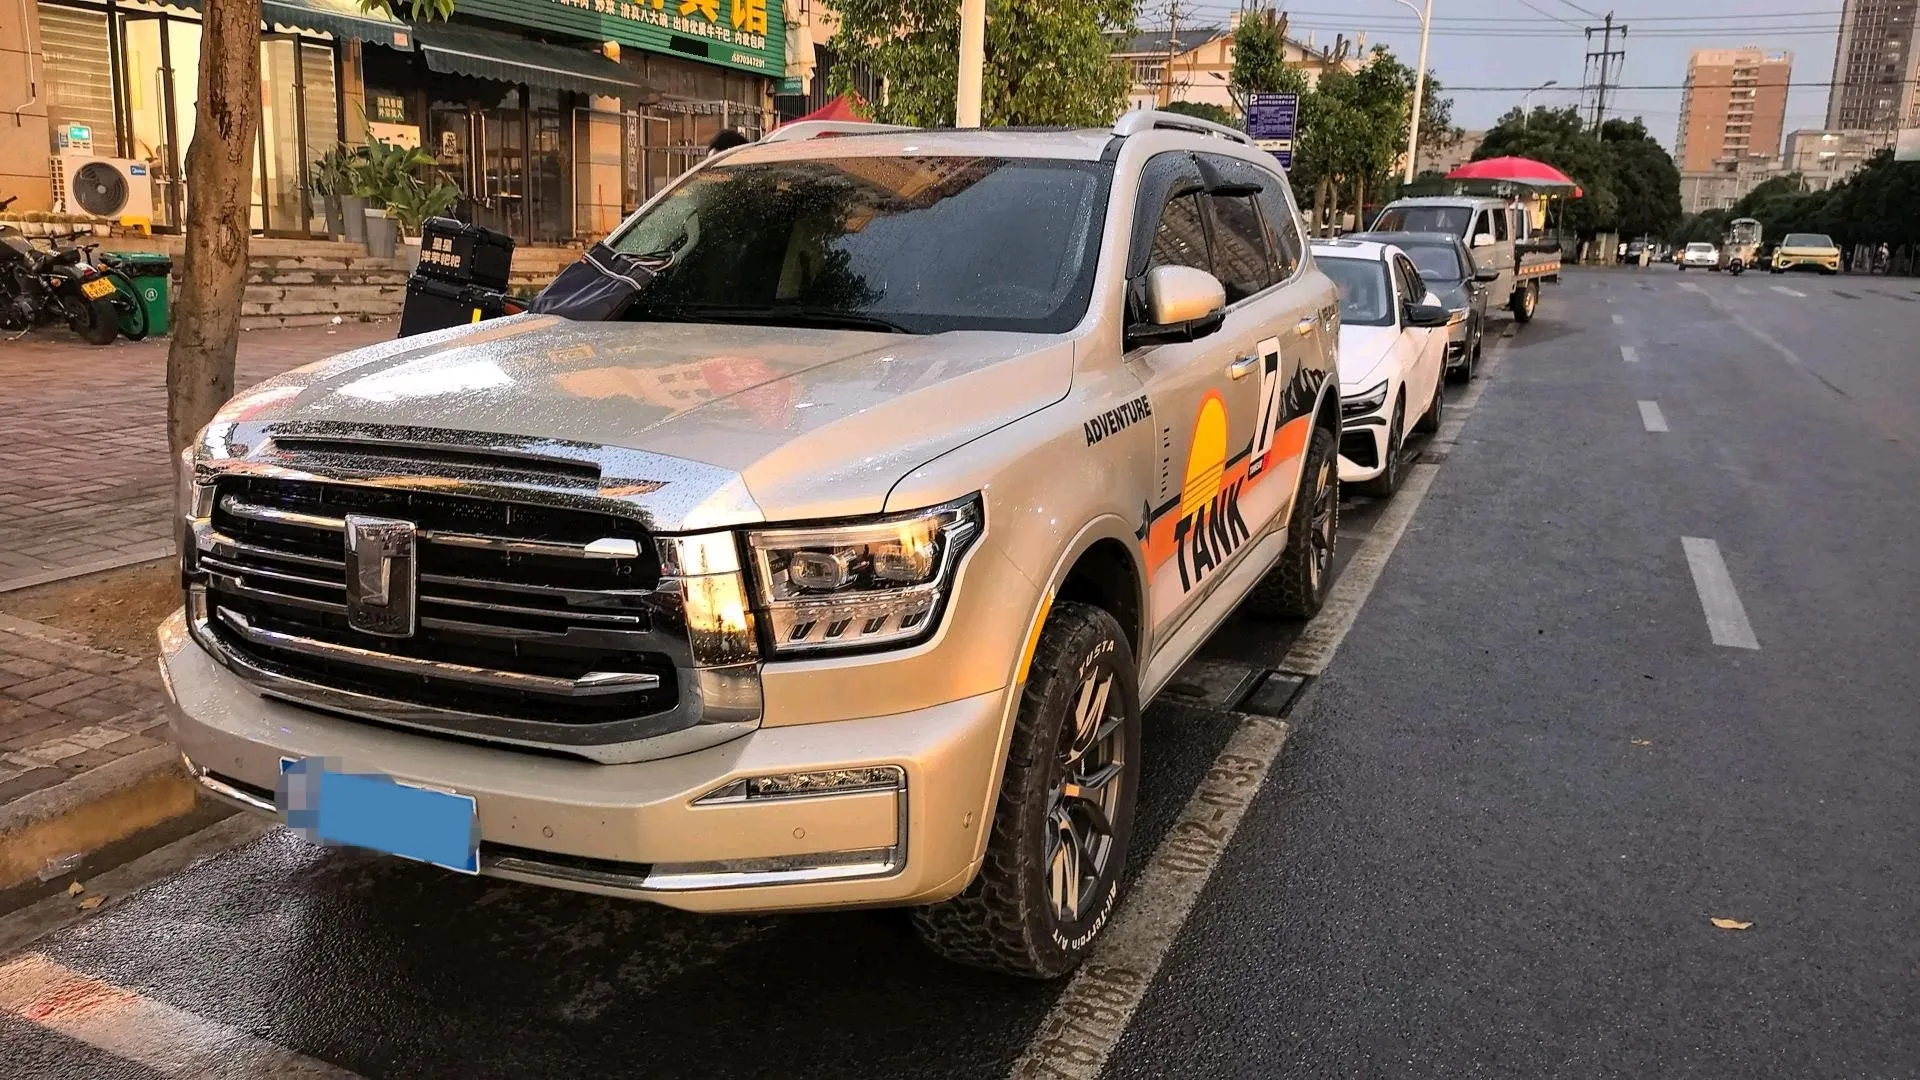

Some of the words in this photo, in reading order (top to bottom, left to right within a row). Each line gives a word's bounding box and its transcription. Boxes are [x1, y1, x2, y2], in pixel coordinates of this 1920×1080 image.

[594, 0, 615, 15] 炒菜
[620, 3, 668, 28] 清真八大碗
[673, 16, 730, 42] 出售优质牛干巴
[1083, 394, 1151, 447] ADVENTURE
[1173, 475, 1251, 594] TANK
[1079, 640, 1114, 679] YUSTA
